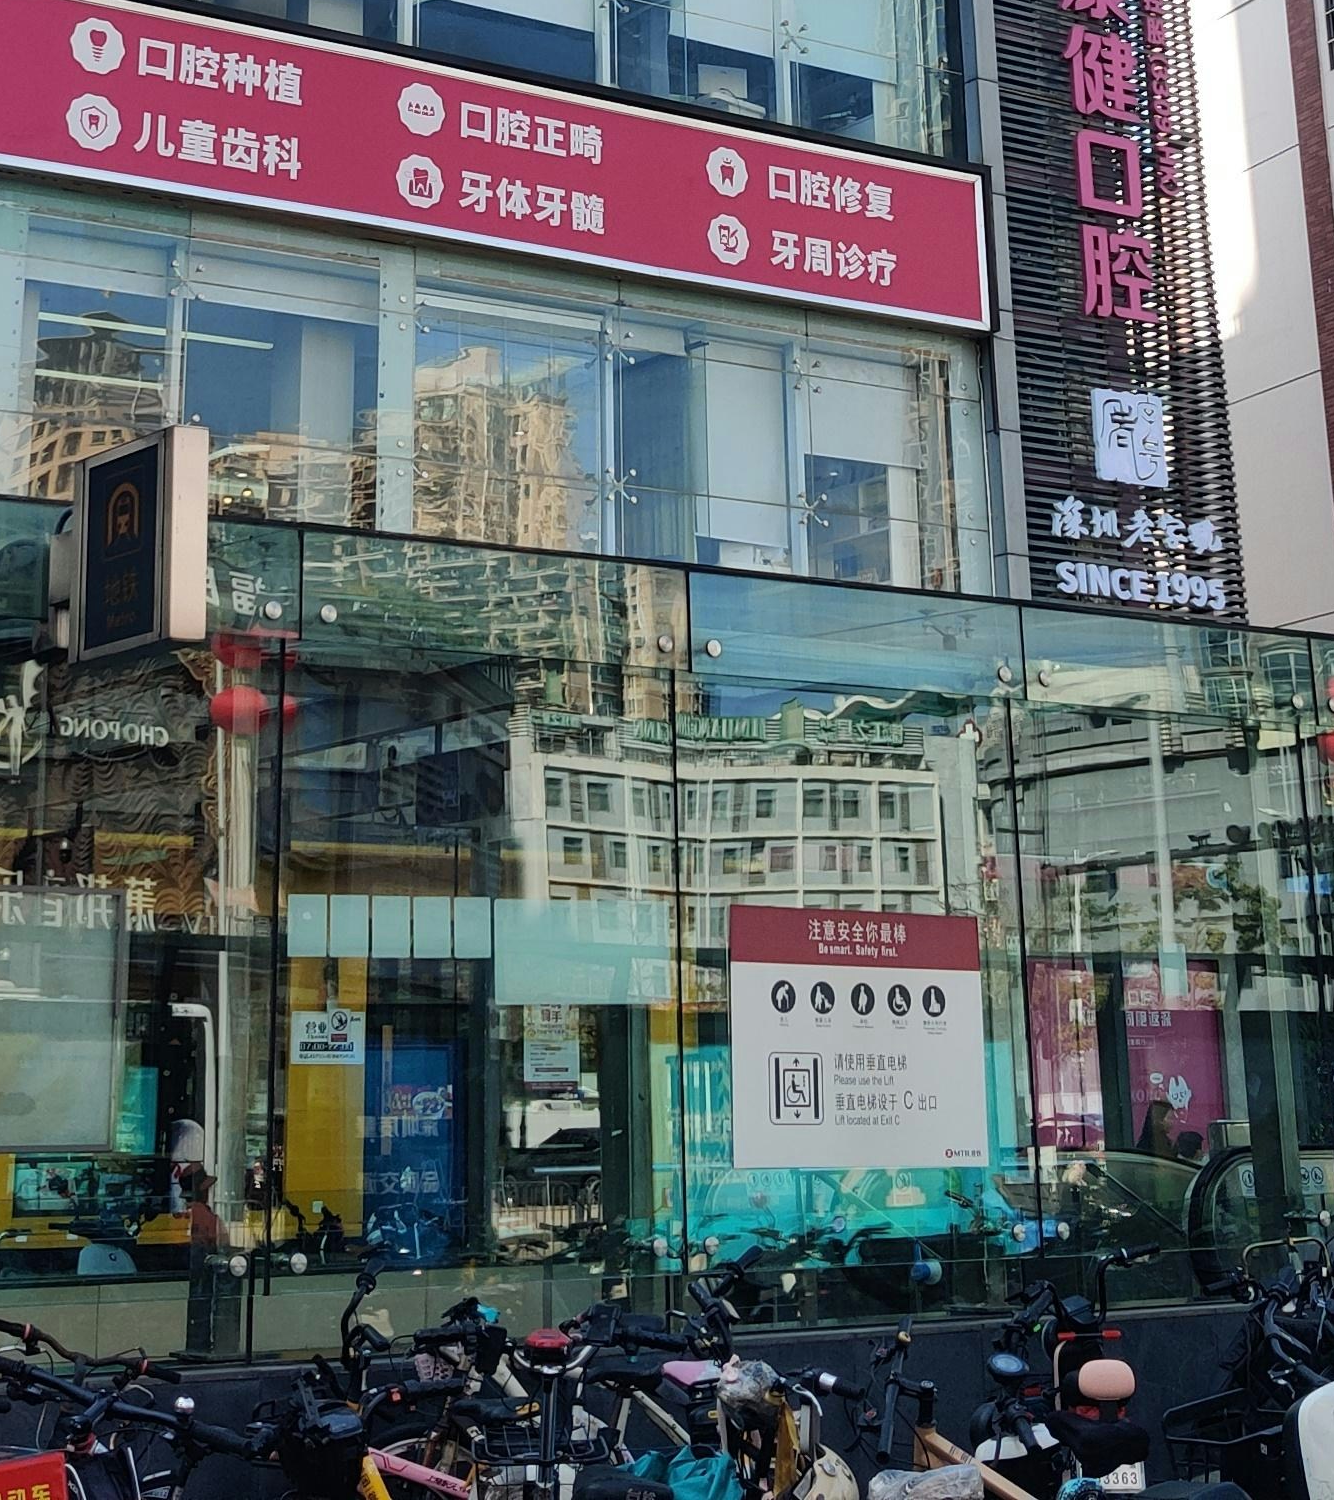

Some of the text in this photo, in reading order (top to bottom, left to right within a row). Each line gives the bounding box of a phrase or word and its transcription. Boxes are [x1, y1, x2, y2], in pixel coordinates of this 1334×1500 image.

[136, 36, 304, 107] 口腔种植
[133, 112, 303, 182] 儿童齿科
[460, 100, 604, 165] 口腔正畸
[460, 169, 606, 235] 牙体牙髓
[768, 164, 896, 222] 口腔修复
[769, 229, 898, 287] 牙周诊疗
[1055, 561, 1226, 611] SINCE 1995
[808, 918, 907, 944] 注意安全你最棒
[818, 943, 828, 955] Be
[855, 945, 878, 959] Safety
[834, 1052, 907, 1071] 请使用垂直电梯
[834, 1075, 894, 1086] Please use the Lift
[835, 1090, 937, 1112] 垂直电梯设于 C 出口
[835, 1115, 845, 1125] Lift
[846, 1115, 871, 1126] located
[873, 1116, 879, 1126] at
[881, 1115, 893, 1126] Exit
